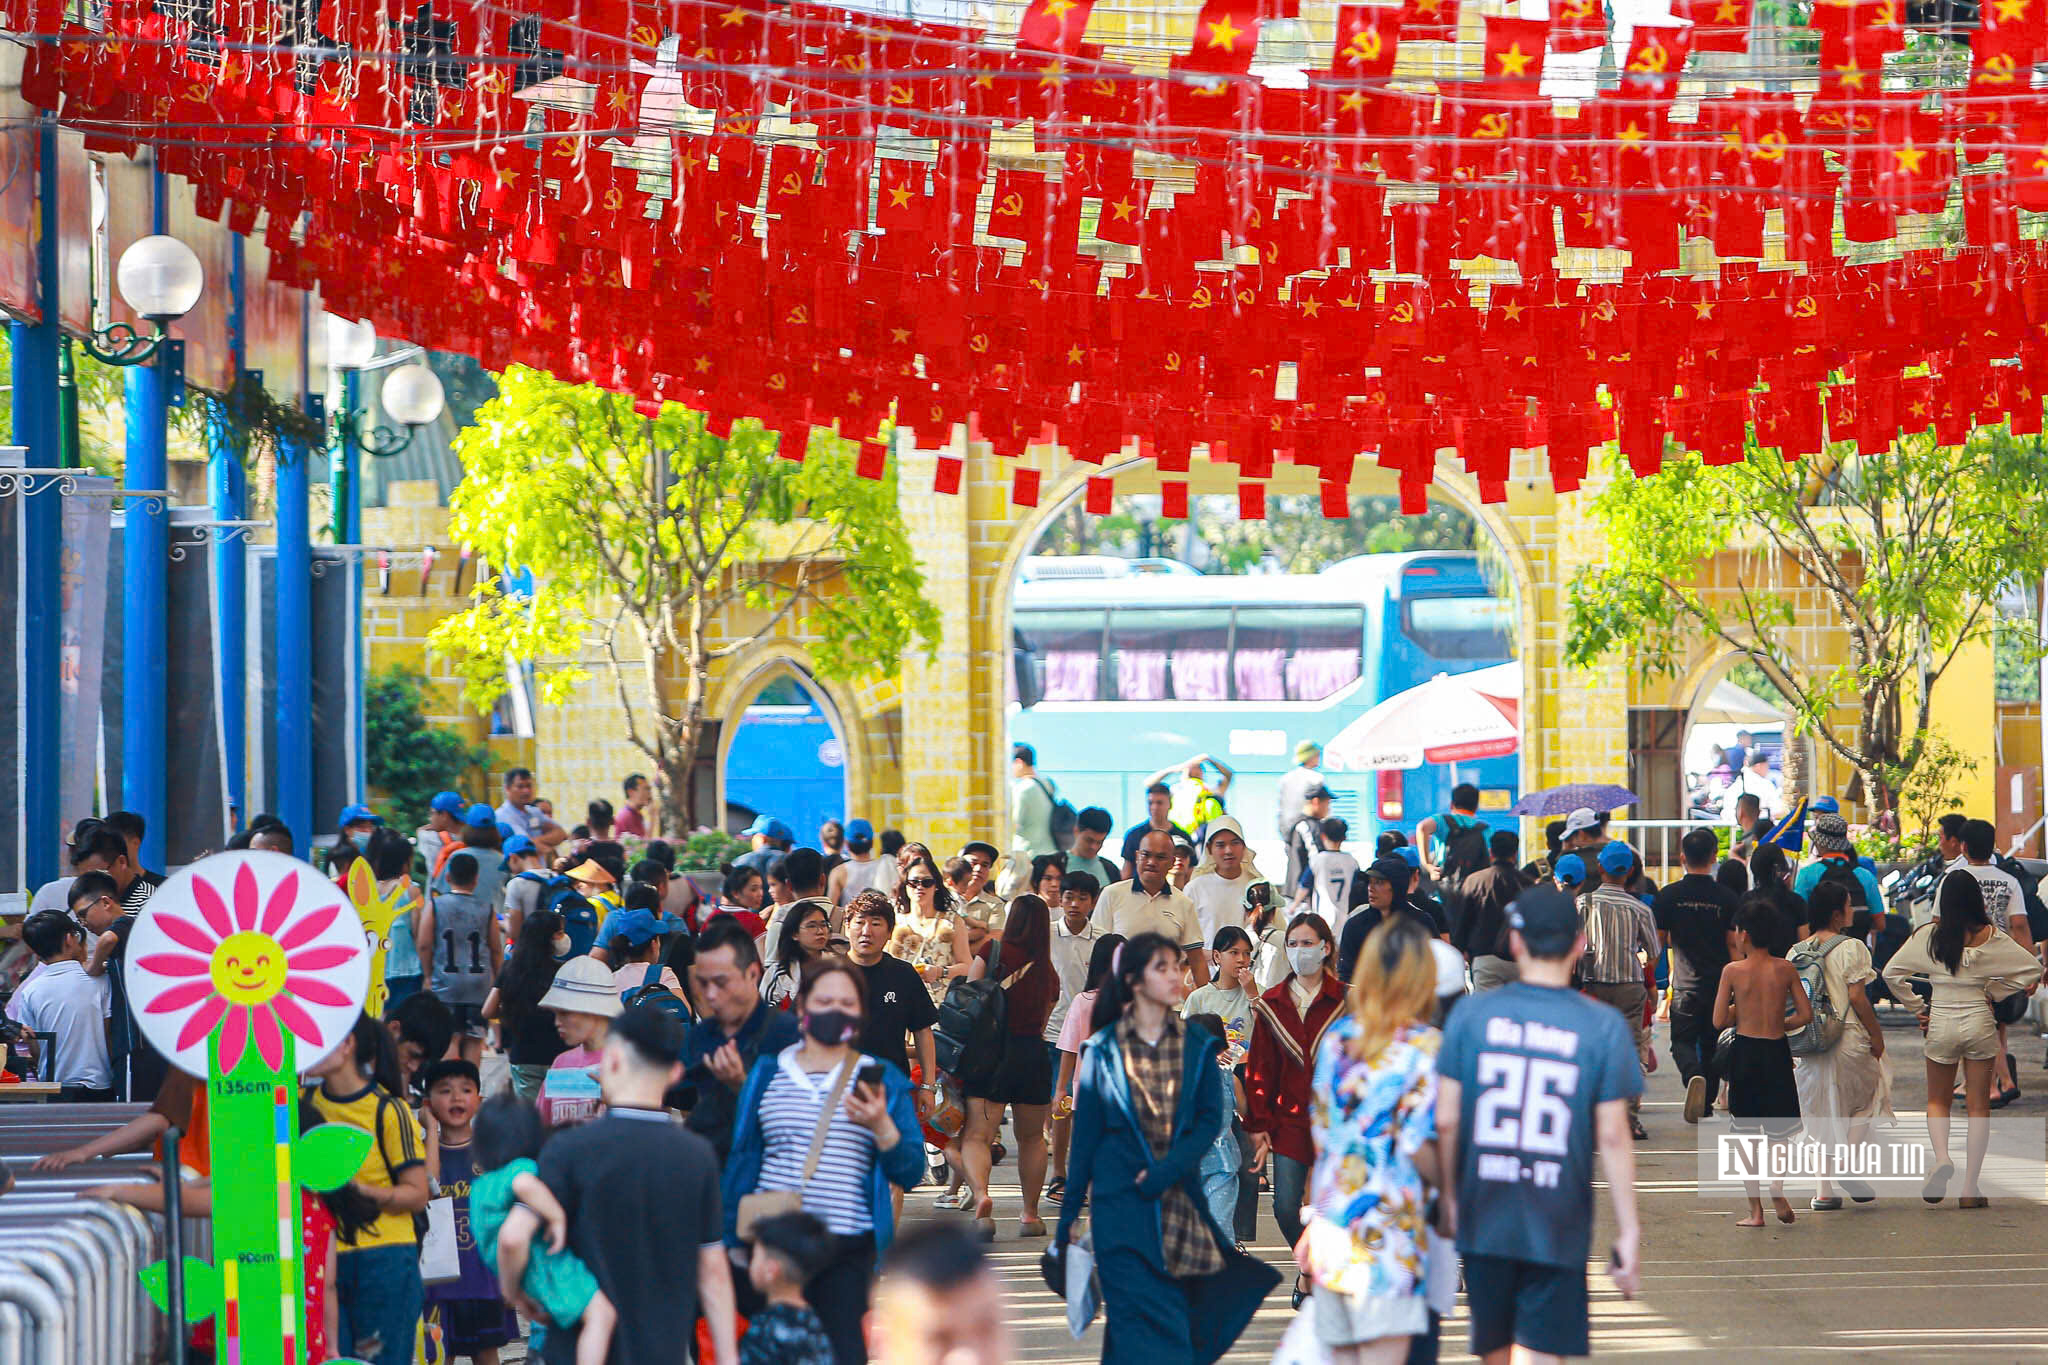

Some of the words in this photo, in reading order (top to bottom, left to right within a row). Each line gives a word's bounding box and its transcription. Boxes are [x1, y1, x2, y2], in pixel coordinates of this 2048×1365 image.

[1330, 878, 1345, 902] 7
[443, 928, 484, 973] 11
[216, 1080, 271, 1095] 135cm
[1474, 1052, 1580, 1156] 26
[238, 1252, 275, 1264] 90cm
